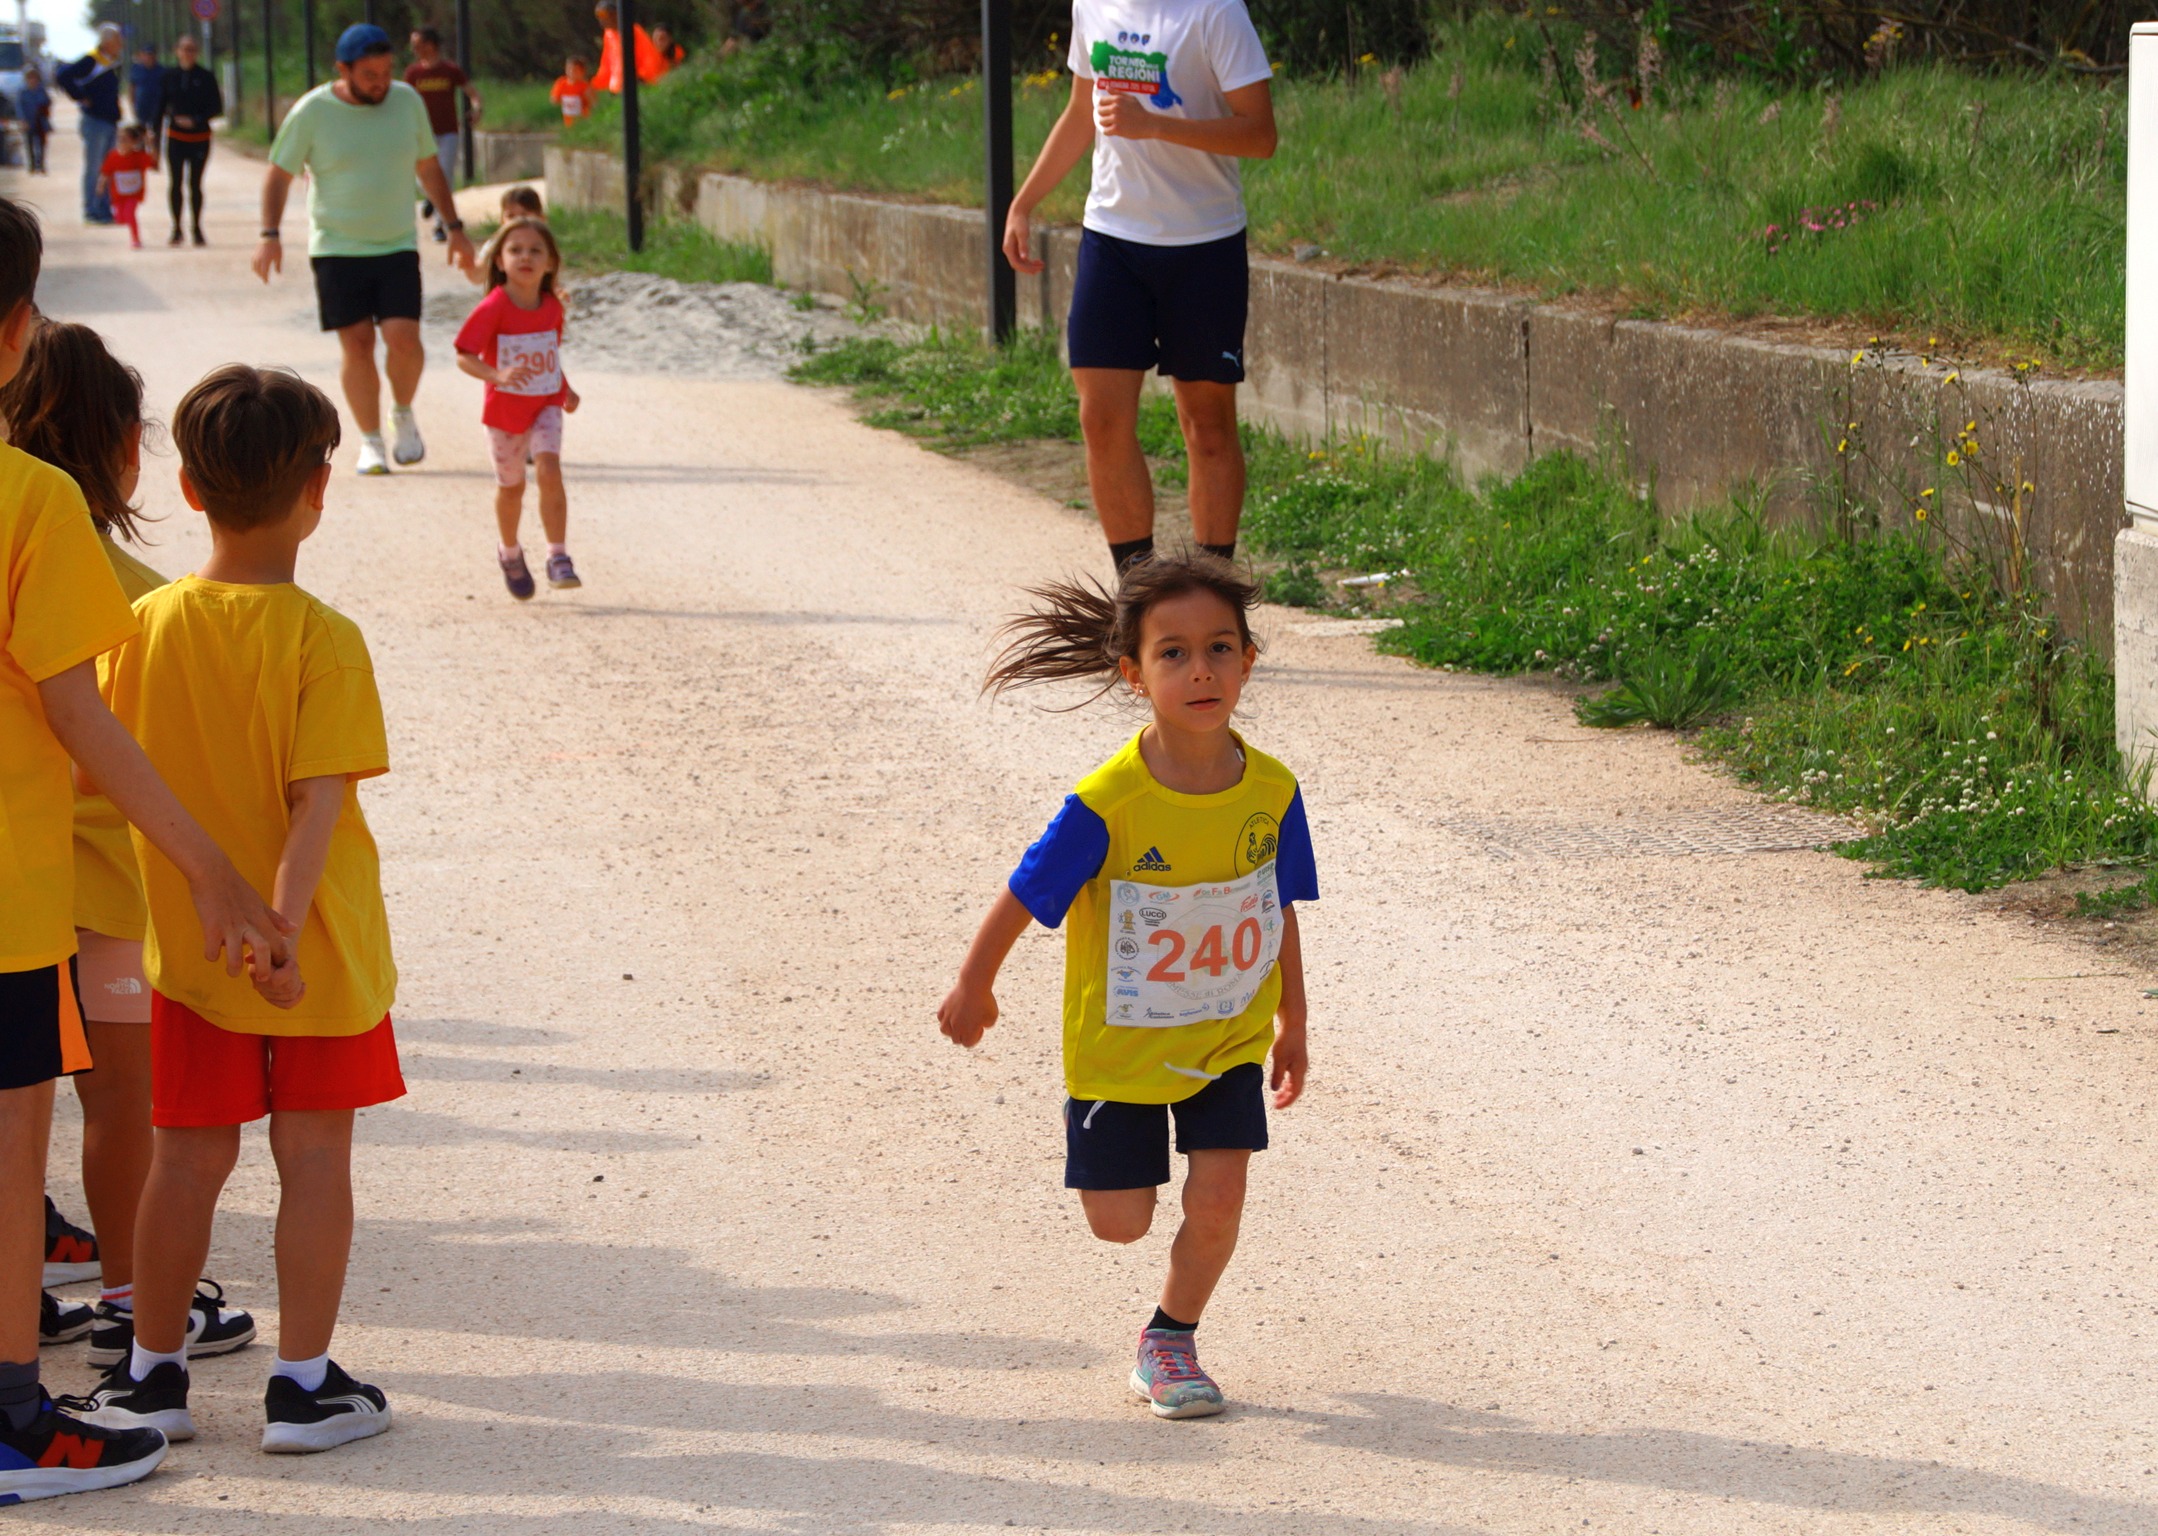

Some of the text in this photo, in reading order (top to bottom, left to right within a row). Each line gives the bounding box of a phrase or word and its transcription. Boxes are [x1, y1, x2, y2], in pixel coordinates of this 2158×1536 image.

[1109, 56, 1146, 68] TORNEO
[1108, 66, 1160, 82] REGIONI
[1133, 861, 1172, 873] adidas
[1141, 909, 1165, 919] LUCCI
[1146, 917, 1262, 982] 240
